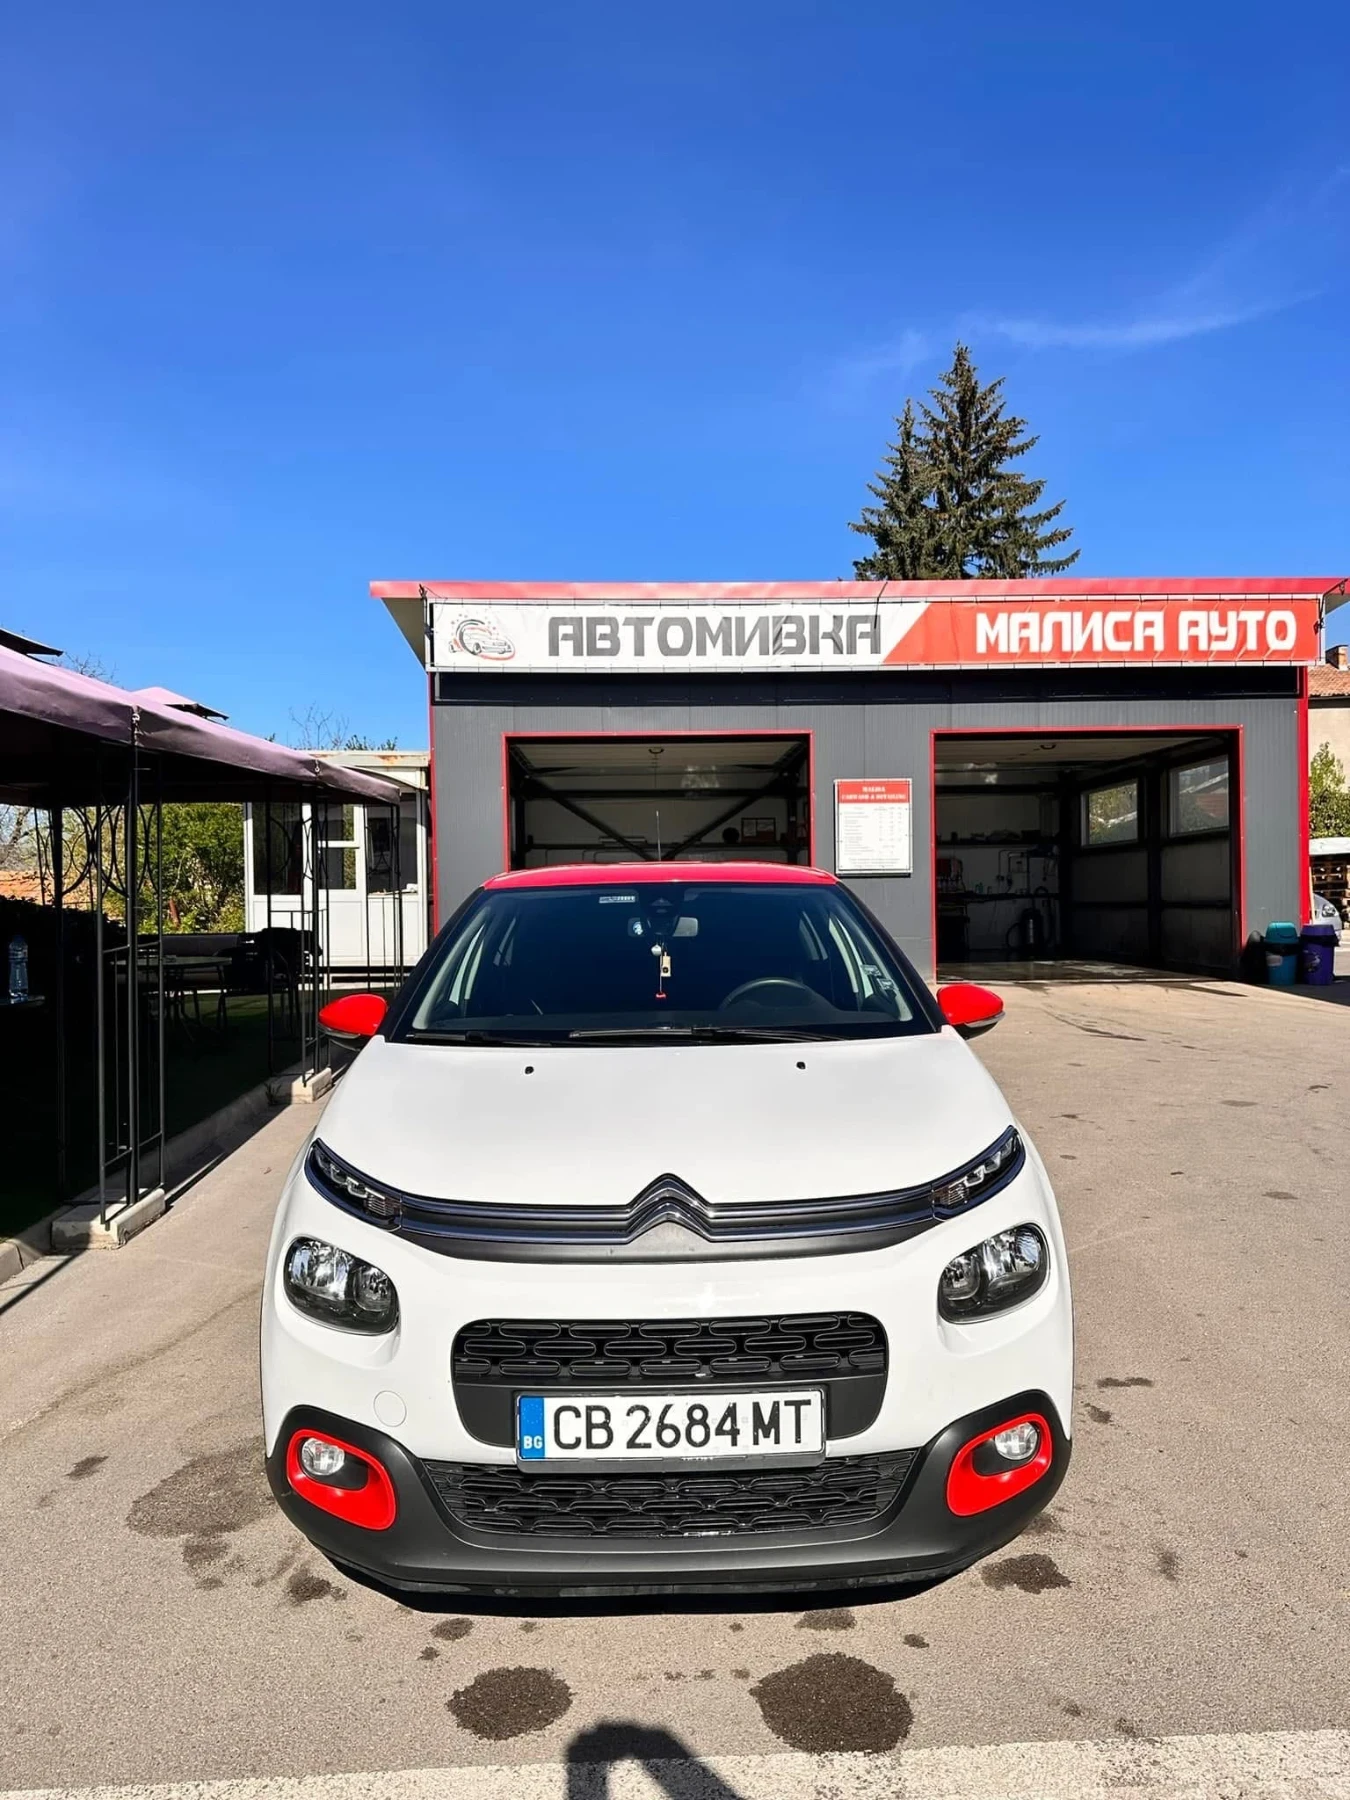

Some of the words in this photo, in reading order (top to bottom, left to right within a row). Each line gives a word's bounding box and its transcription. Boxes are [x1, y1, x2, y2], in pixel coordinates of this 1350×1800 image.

[549, 615, 881, 656] АВТОМИВКА
[976, 611, 1164, 654] МАЛИСА
[1179, 610, 1296, 654] АУТО
[523, 1436, 543, 1449] BG
[554, 1405, 614, 1449] CB
[626, 1402, 740, 1448] 2684
[752, 1399, 812, 1446] MT
